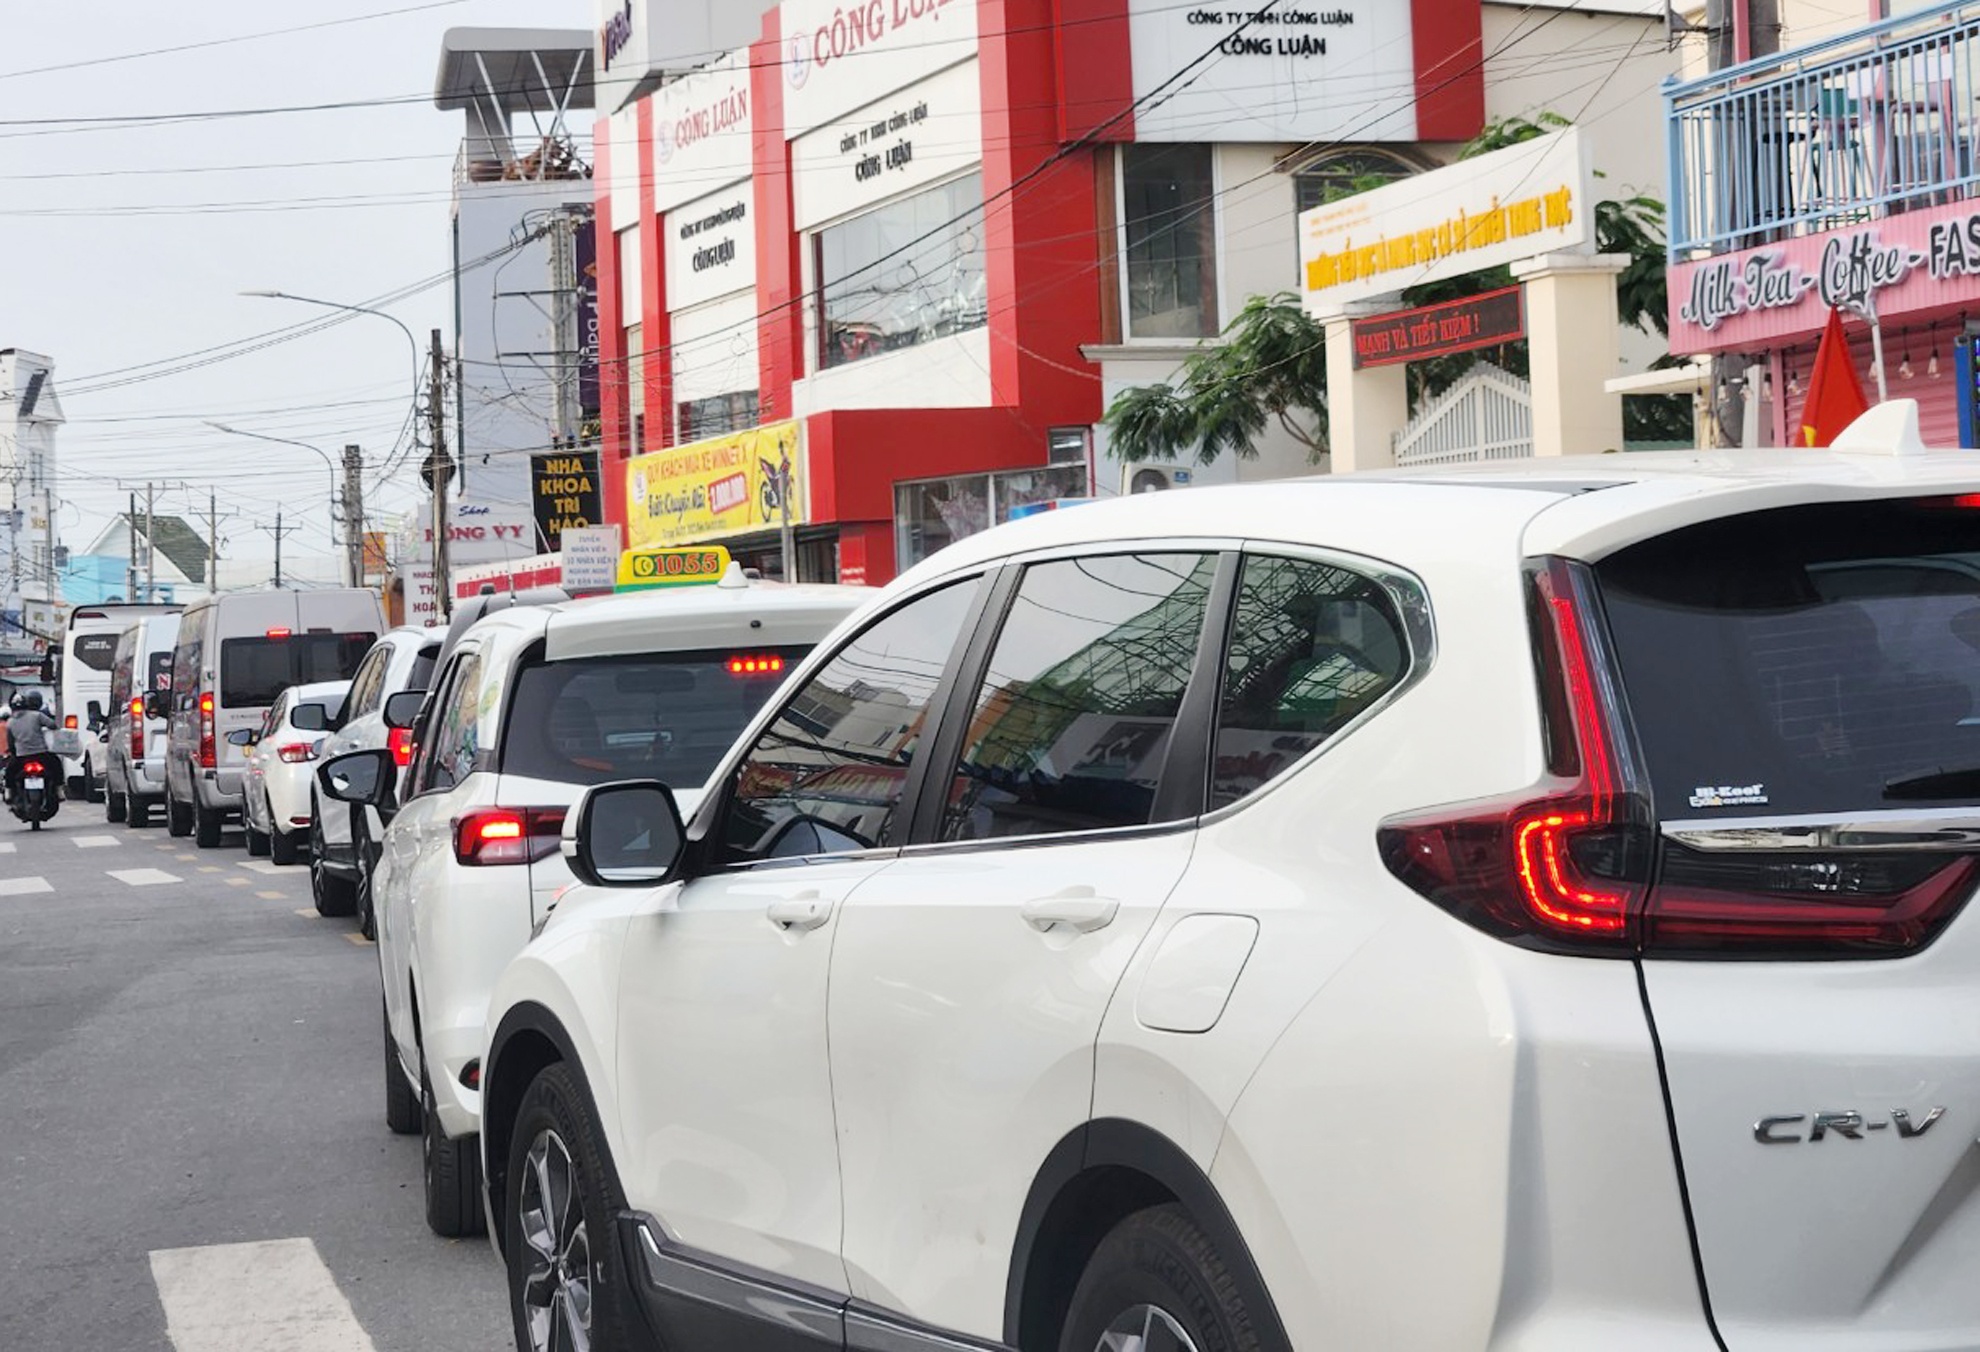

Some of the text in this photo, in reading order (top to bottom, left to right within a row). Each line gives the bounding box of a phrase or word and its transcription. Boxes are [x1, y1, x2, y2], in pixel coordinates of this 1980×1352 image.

[1187, 9, 1223, 25] CÔNG
[1226, 12, 1243, 24] TY
[1282, 9, 1318, 25] CÔNG
[1321, 9, 1354, 28] LUẬN
[1220, 34, 1327, 60] CÔNG LUẬN
[675, 106, 710, 150] CÔNG
[712, 85, 747, 133] LUẬN
[1681, 262, 1738, 328] Milk
[1745, 254, 1794, 305] Tea
[1819, 231, 1900, 308] Coffee
[1391, 322, 1410, 350] VÀ
[544, 457, 584, 475] NHA
[540, 476, 592, 496] KHOA
[458, 505, 490, 517] Shop
[655, 552, 718, 577] 1055
[1753, 1105, 1948, 1145] CR-V
